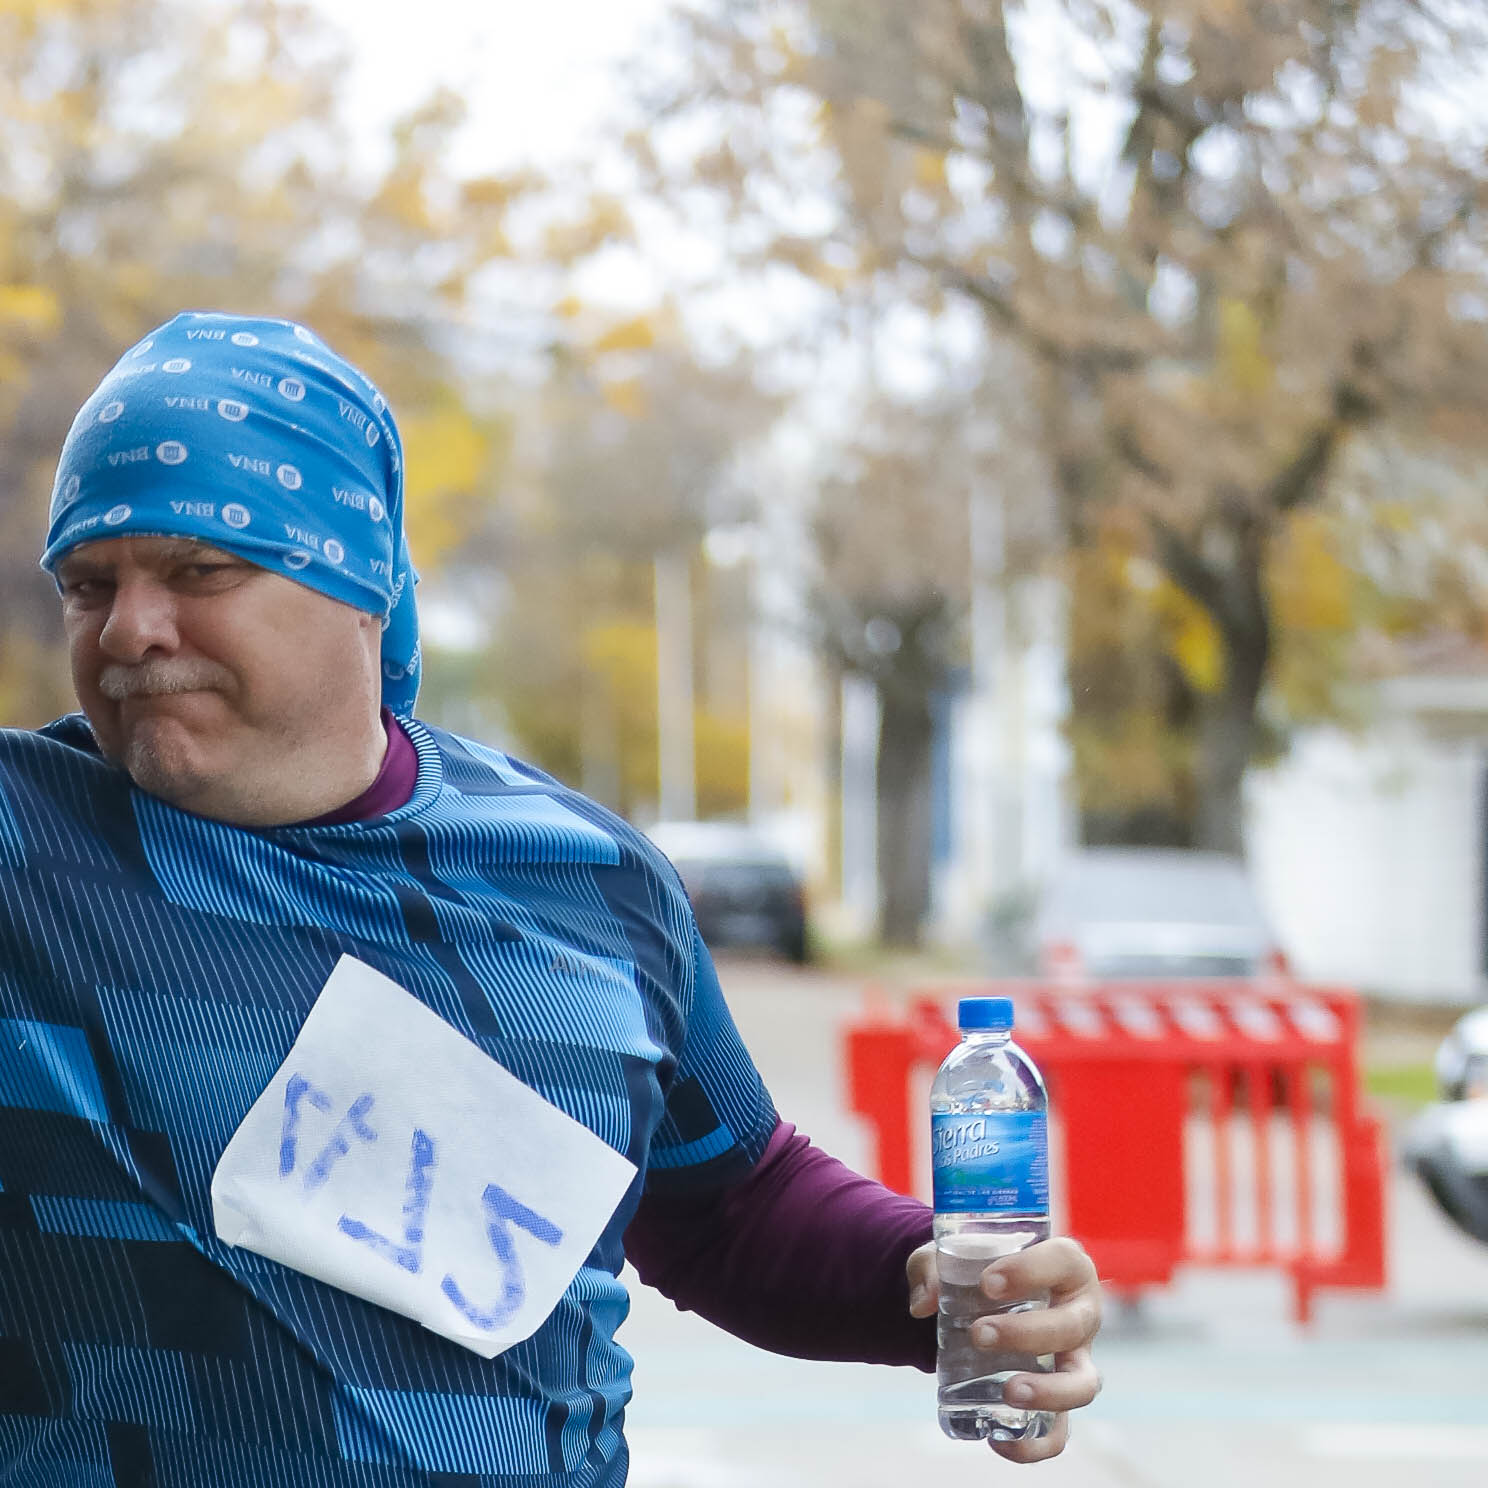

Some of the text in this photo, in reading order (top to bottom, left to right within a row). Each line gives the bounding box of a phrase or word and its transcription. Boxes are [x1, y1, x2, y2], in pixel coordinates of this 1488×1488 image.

[186, 329, 227, 341] BNA
[231, 367, 273, 388] BNA
[164, 396, 209, 411] BNA
[339, 400, 367, 430] BNA
[107, 446, 150, 466] BNA
[227, 452, 271, 478] BNA
[169, 500, 216, 517] BNA
[332, 487, 366, 510] BNA
[284, 523, 320, 549] BNA
[369, 558, 390, 577] NA
[953, 1141, 1000, 1165] Padres
